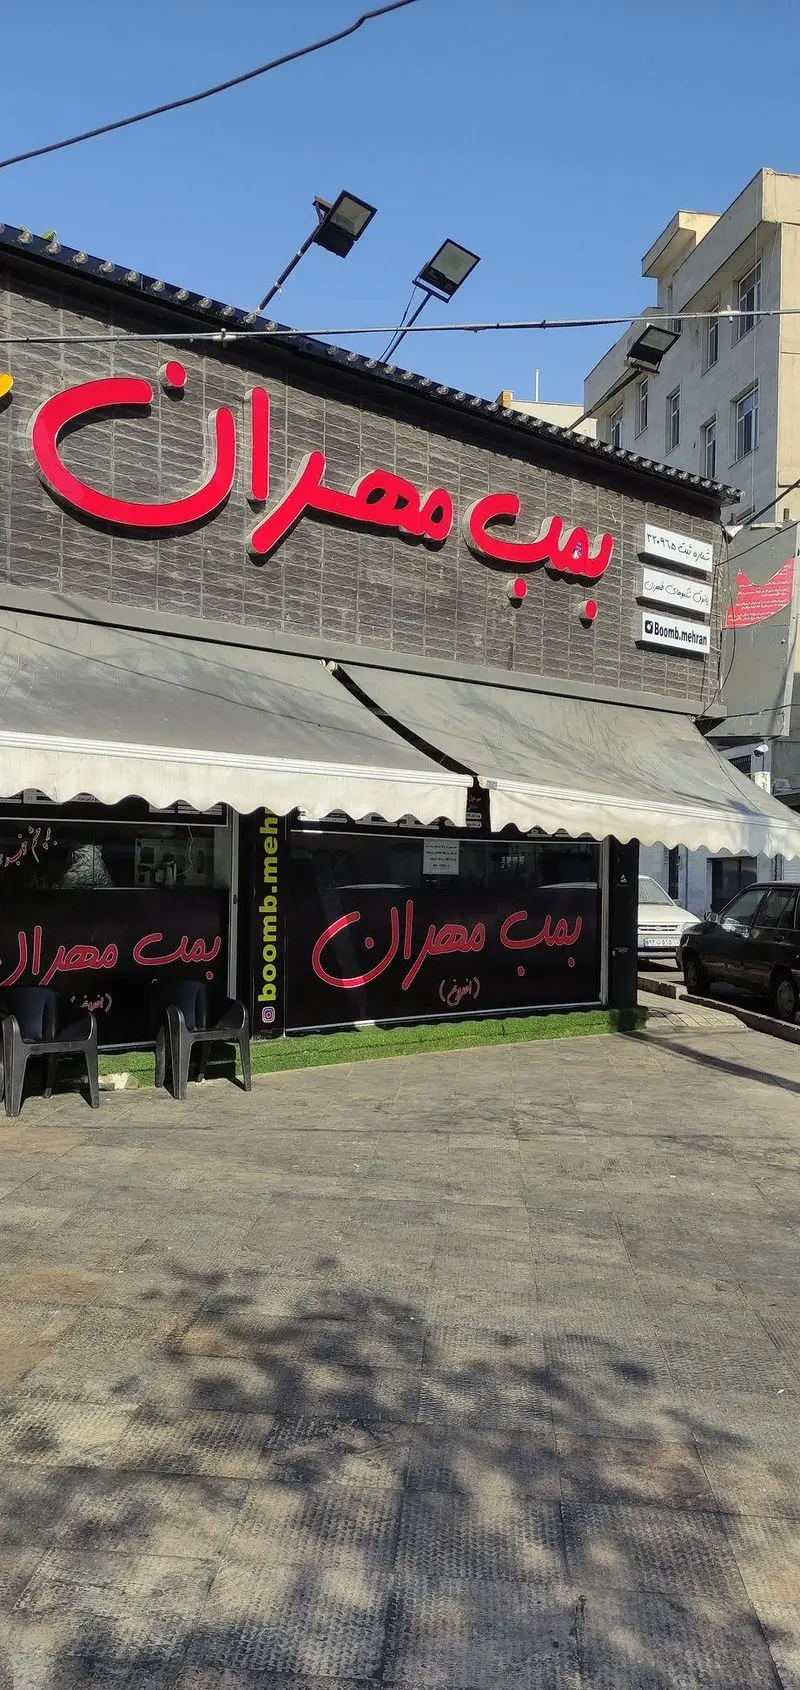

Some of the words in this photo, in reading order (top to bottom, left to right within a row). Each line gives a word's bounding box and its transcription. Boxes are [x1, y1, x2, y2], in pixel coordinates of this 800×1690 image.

[32, 360, 454, 555] مهران
[465, 493, 615, 622] بمب
[693, 549, 710, 562] شماره
[654, 621, 708, 645] Boomb.mehran
[311, 899, 486, 990] مهران
[500, 910, 583, 977] بمب
